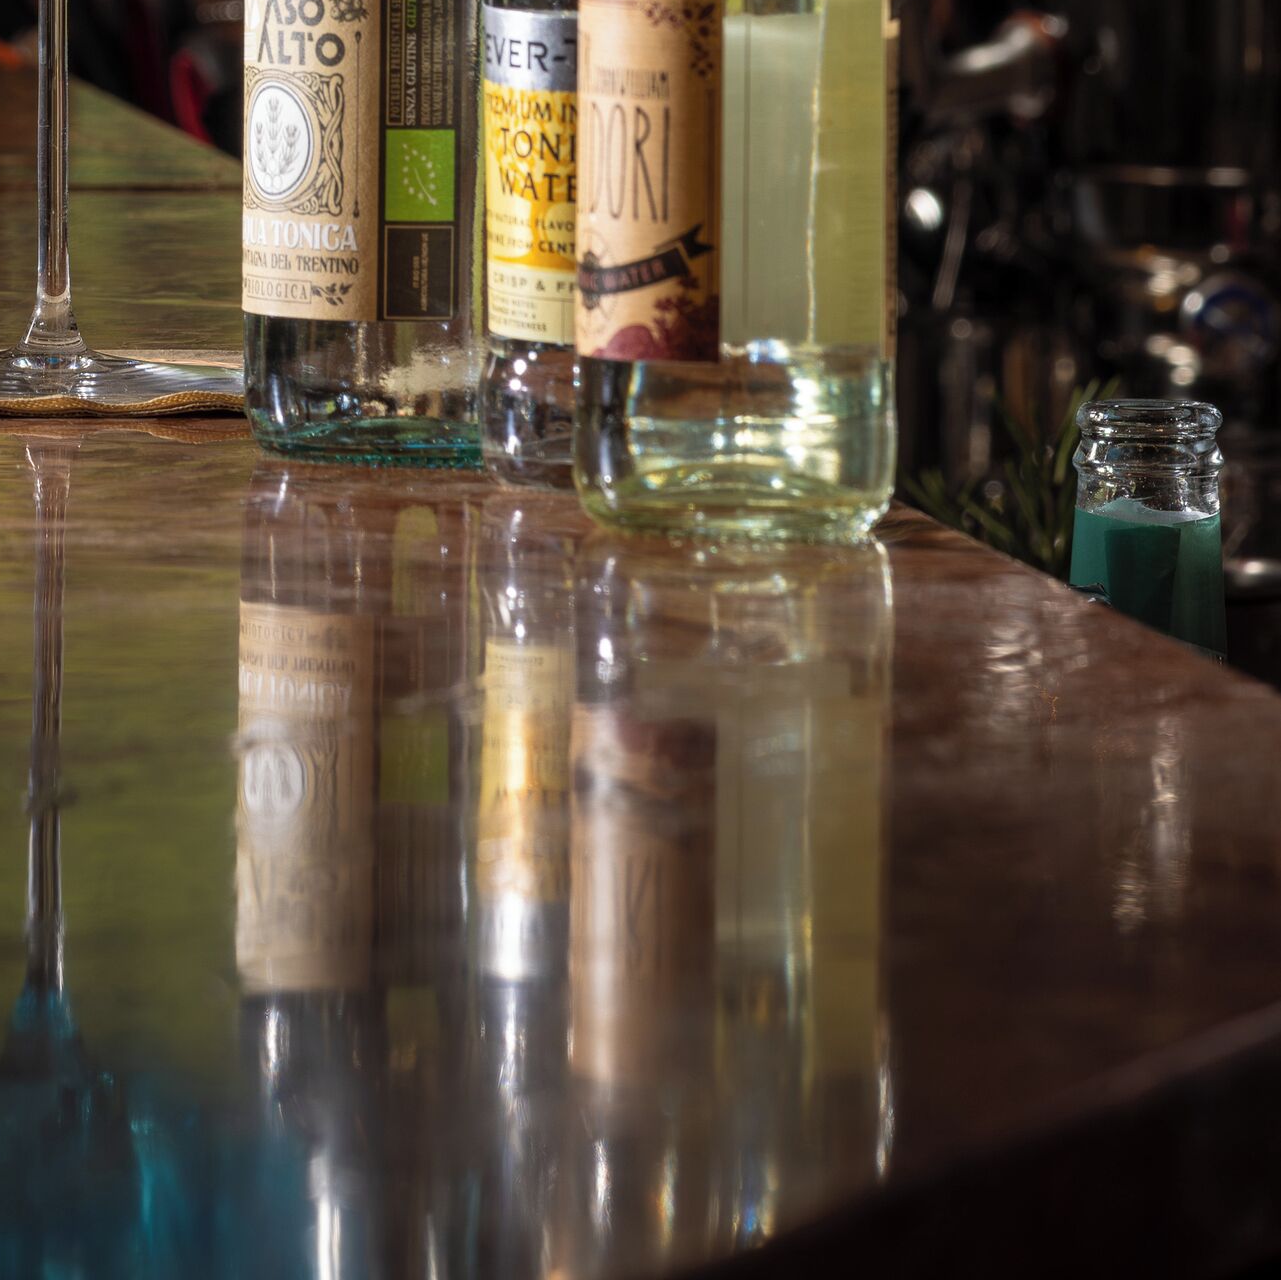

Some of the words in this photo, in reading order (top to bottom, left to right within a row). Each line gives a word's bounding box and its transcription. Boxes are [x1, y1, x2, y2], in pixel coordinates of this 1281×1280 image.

[257, 23, 346, 68] ALTO
[406, 32, 417, 86] GLUTINE
[406, 87, 417, 126] SENZA
[273, 220, 359, 252] TONICA
[297, 255, 360, 275] TRENTINO
[493, 270, 528, 289] CRISP
[536, 278, 546, 292] &
[248, 277, 309, 301] BIOLOGICA
